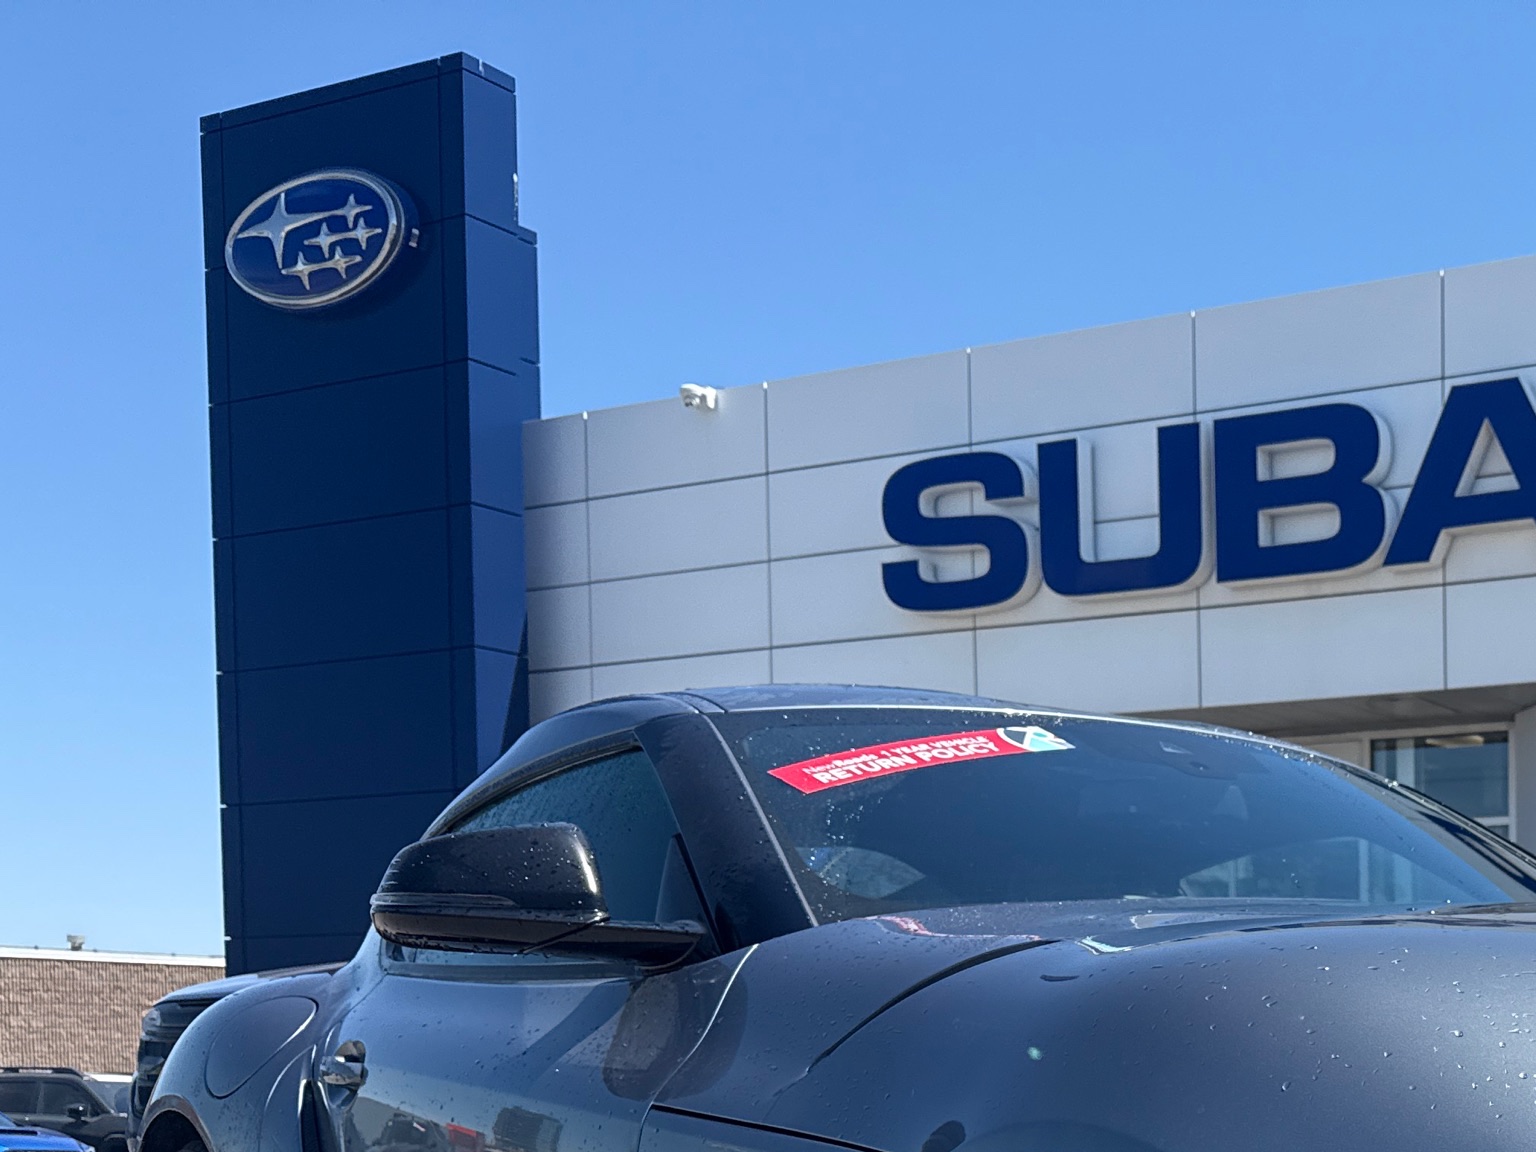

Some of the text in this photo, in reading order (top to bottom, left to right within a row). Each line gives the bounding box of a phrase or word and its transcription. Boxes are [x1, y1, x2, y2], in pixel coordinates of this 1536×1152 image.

[890, 742, 932, 755] YEAR
[929, 735, 990, 749] VEHICLE
[812, 742, 1000, 784] RETURN POLICY
